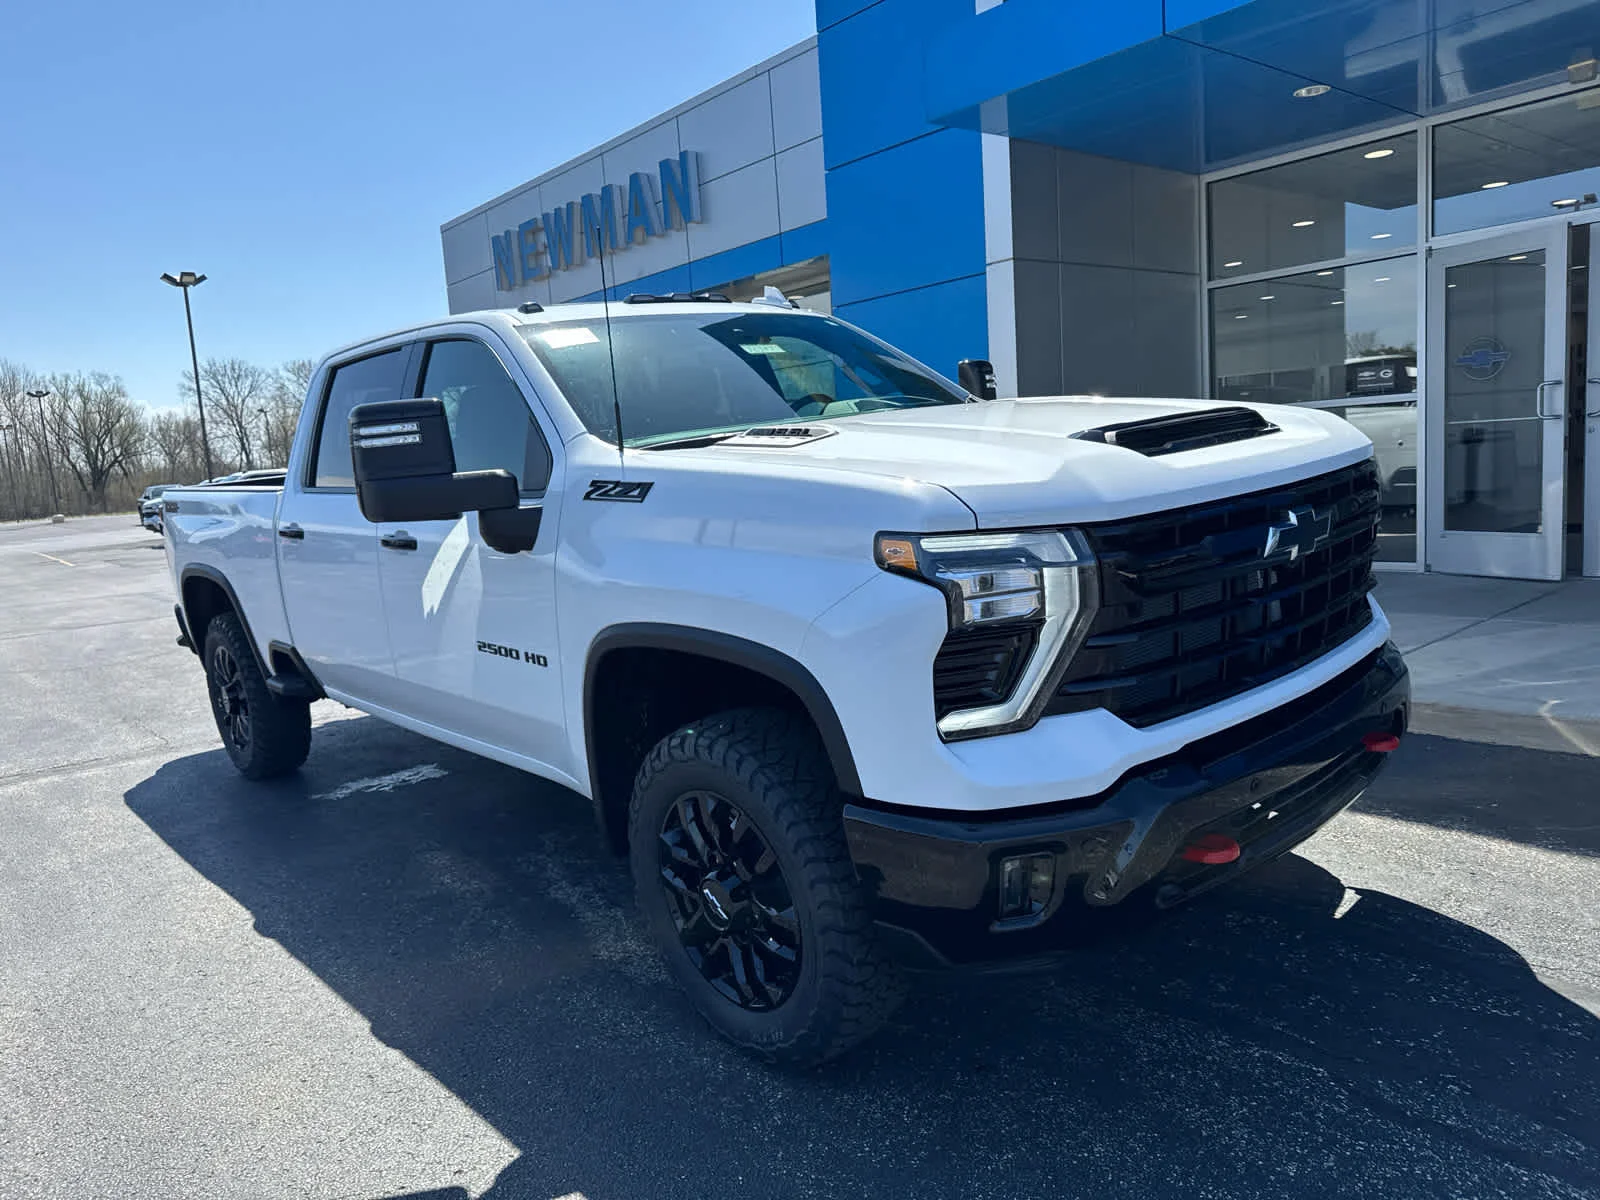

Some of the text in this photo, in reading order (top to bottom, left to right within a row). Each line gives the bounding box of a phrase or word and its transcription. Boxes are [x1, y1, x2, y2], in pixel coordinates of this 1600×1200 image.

[491, 150, 701, 291] NEWMAN
[583, 479, 655, 503] Z71
[476, 640, 548, 668] 2500 HD
